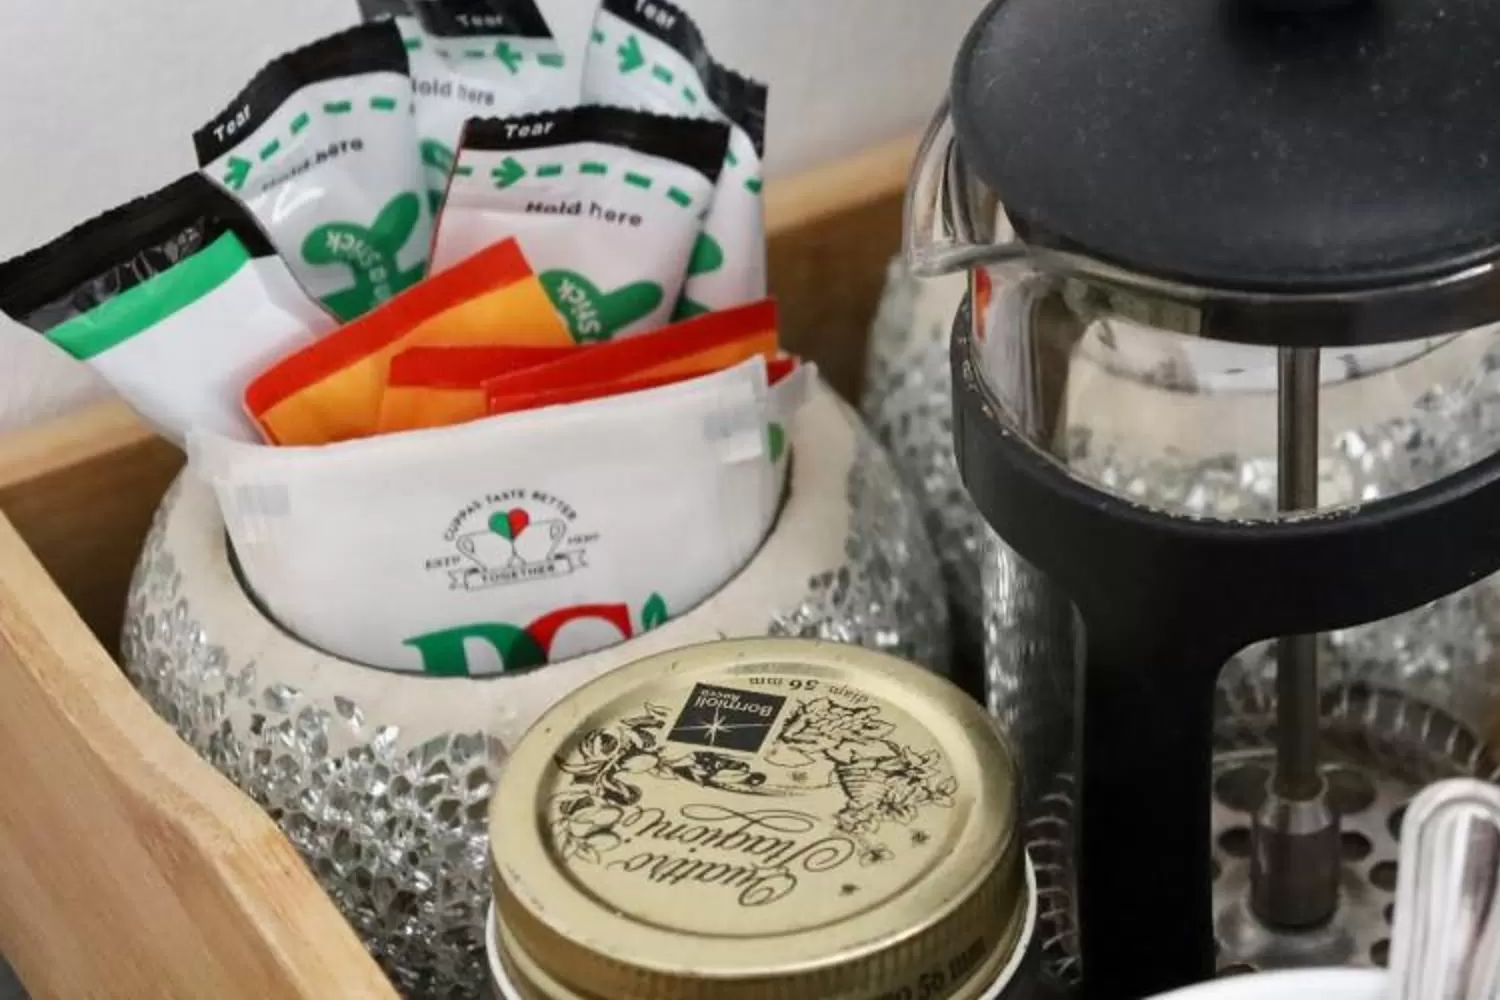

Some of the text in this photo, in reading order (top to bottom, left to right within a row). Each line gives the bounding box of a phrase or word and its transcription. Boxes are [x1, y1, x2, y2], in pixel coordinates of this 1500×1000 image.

[456, 12, 504, 27] Tear
[411, 77, 451, 96] old
[213, 103, 252, 142] Tear
[504, 120, 556, 140] Tear
[524, 200, 643, 228] Hold here
[692, 694, 775, 719] Bormioli
[606, 852, 798, 908] Quattro
